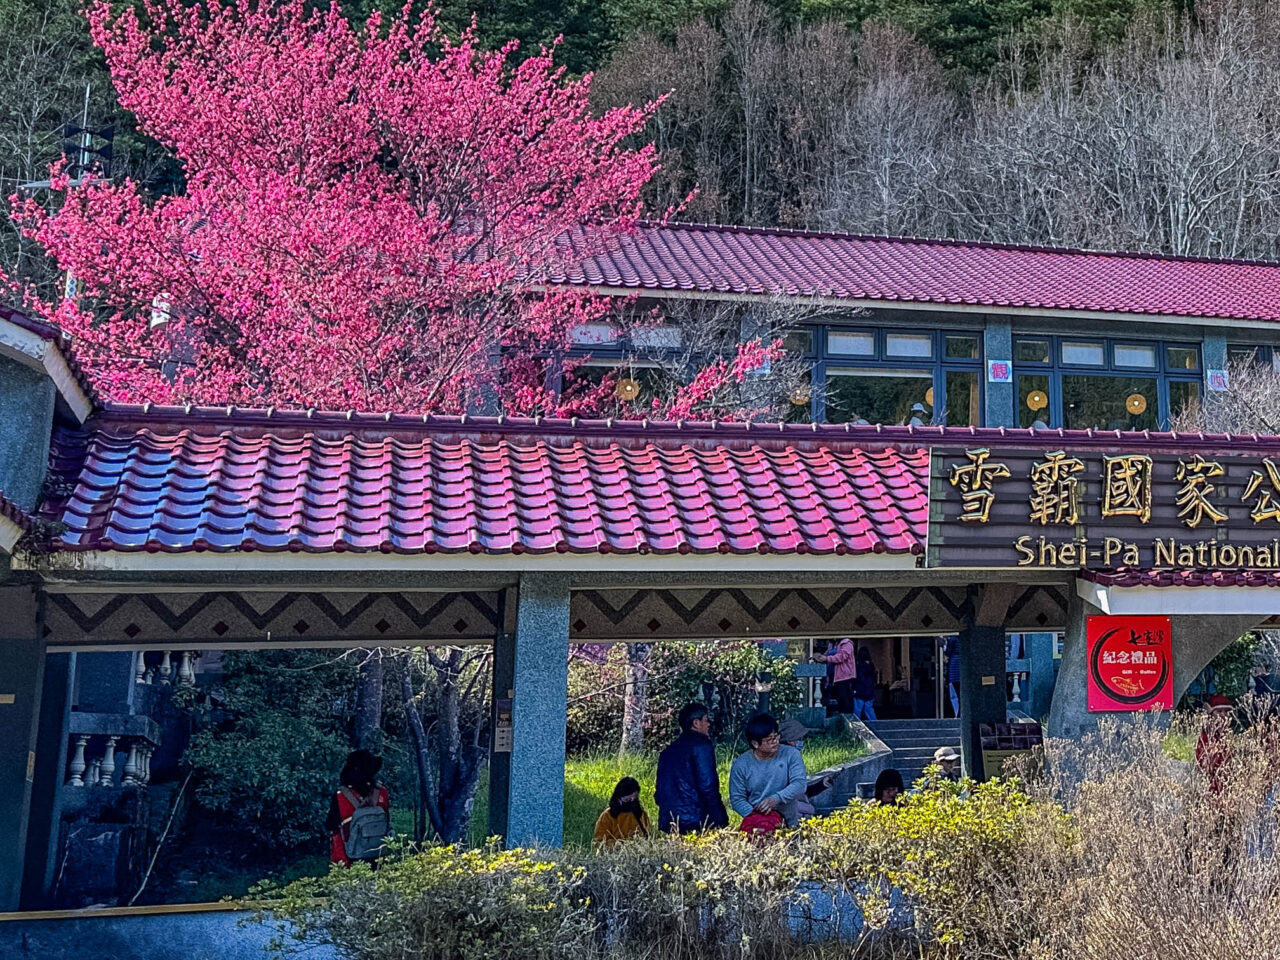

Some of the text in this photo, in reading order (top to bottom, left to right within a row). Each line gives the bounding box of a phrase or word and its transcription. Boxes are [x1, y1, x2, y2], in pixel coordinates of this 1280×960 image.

[1014, 535, 1140, 567] Shei-Pa
[1154, 538, 1280, 568] National
[1102, 650, 1158, 664] 紀念禮品
